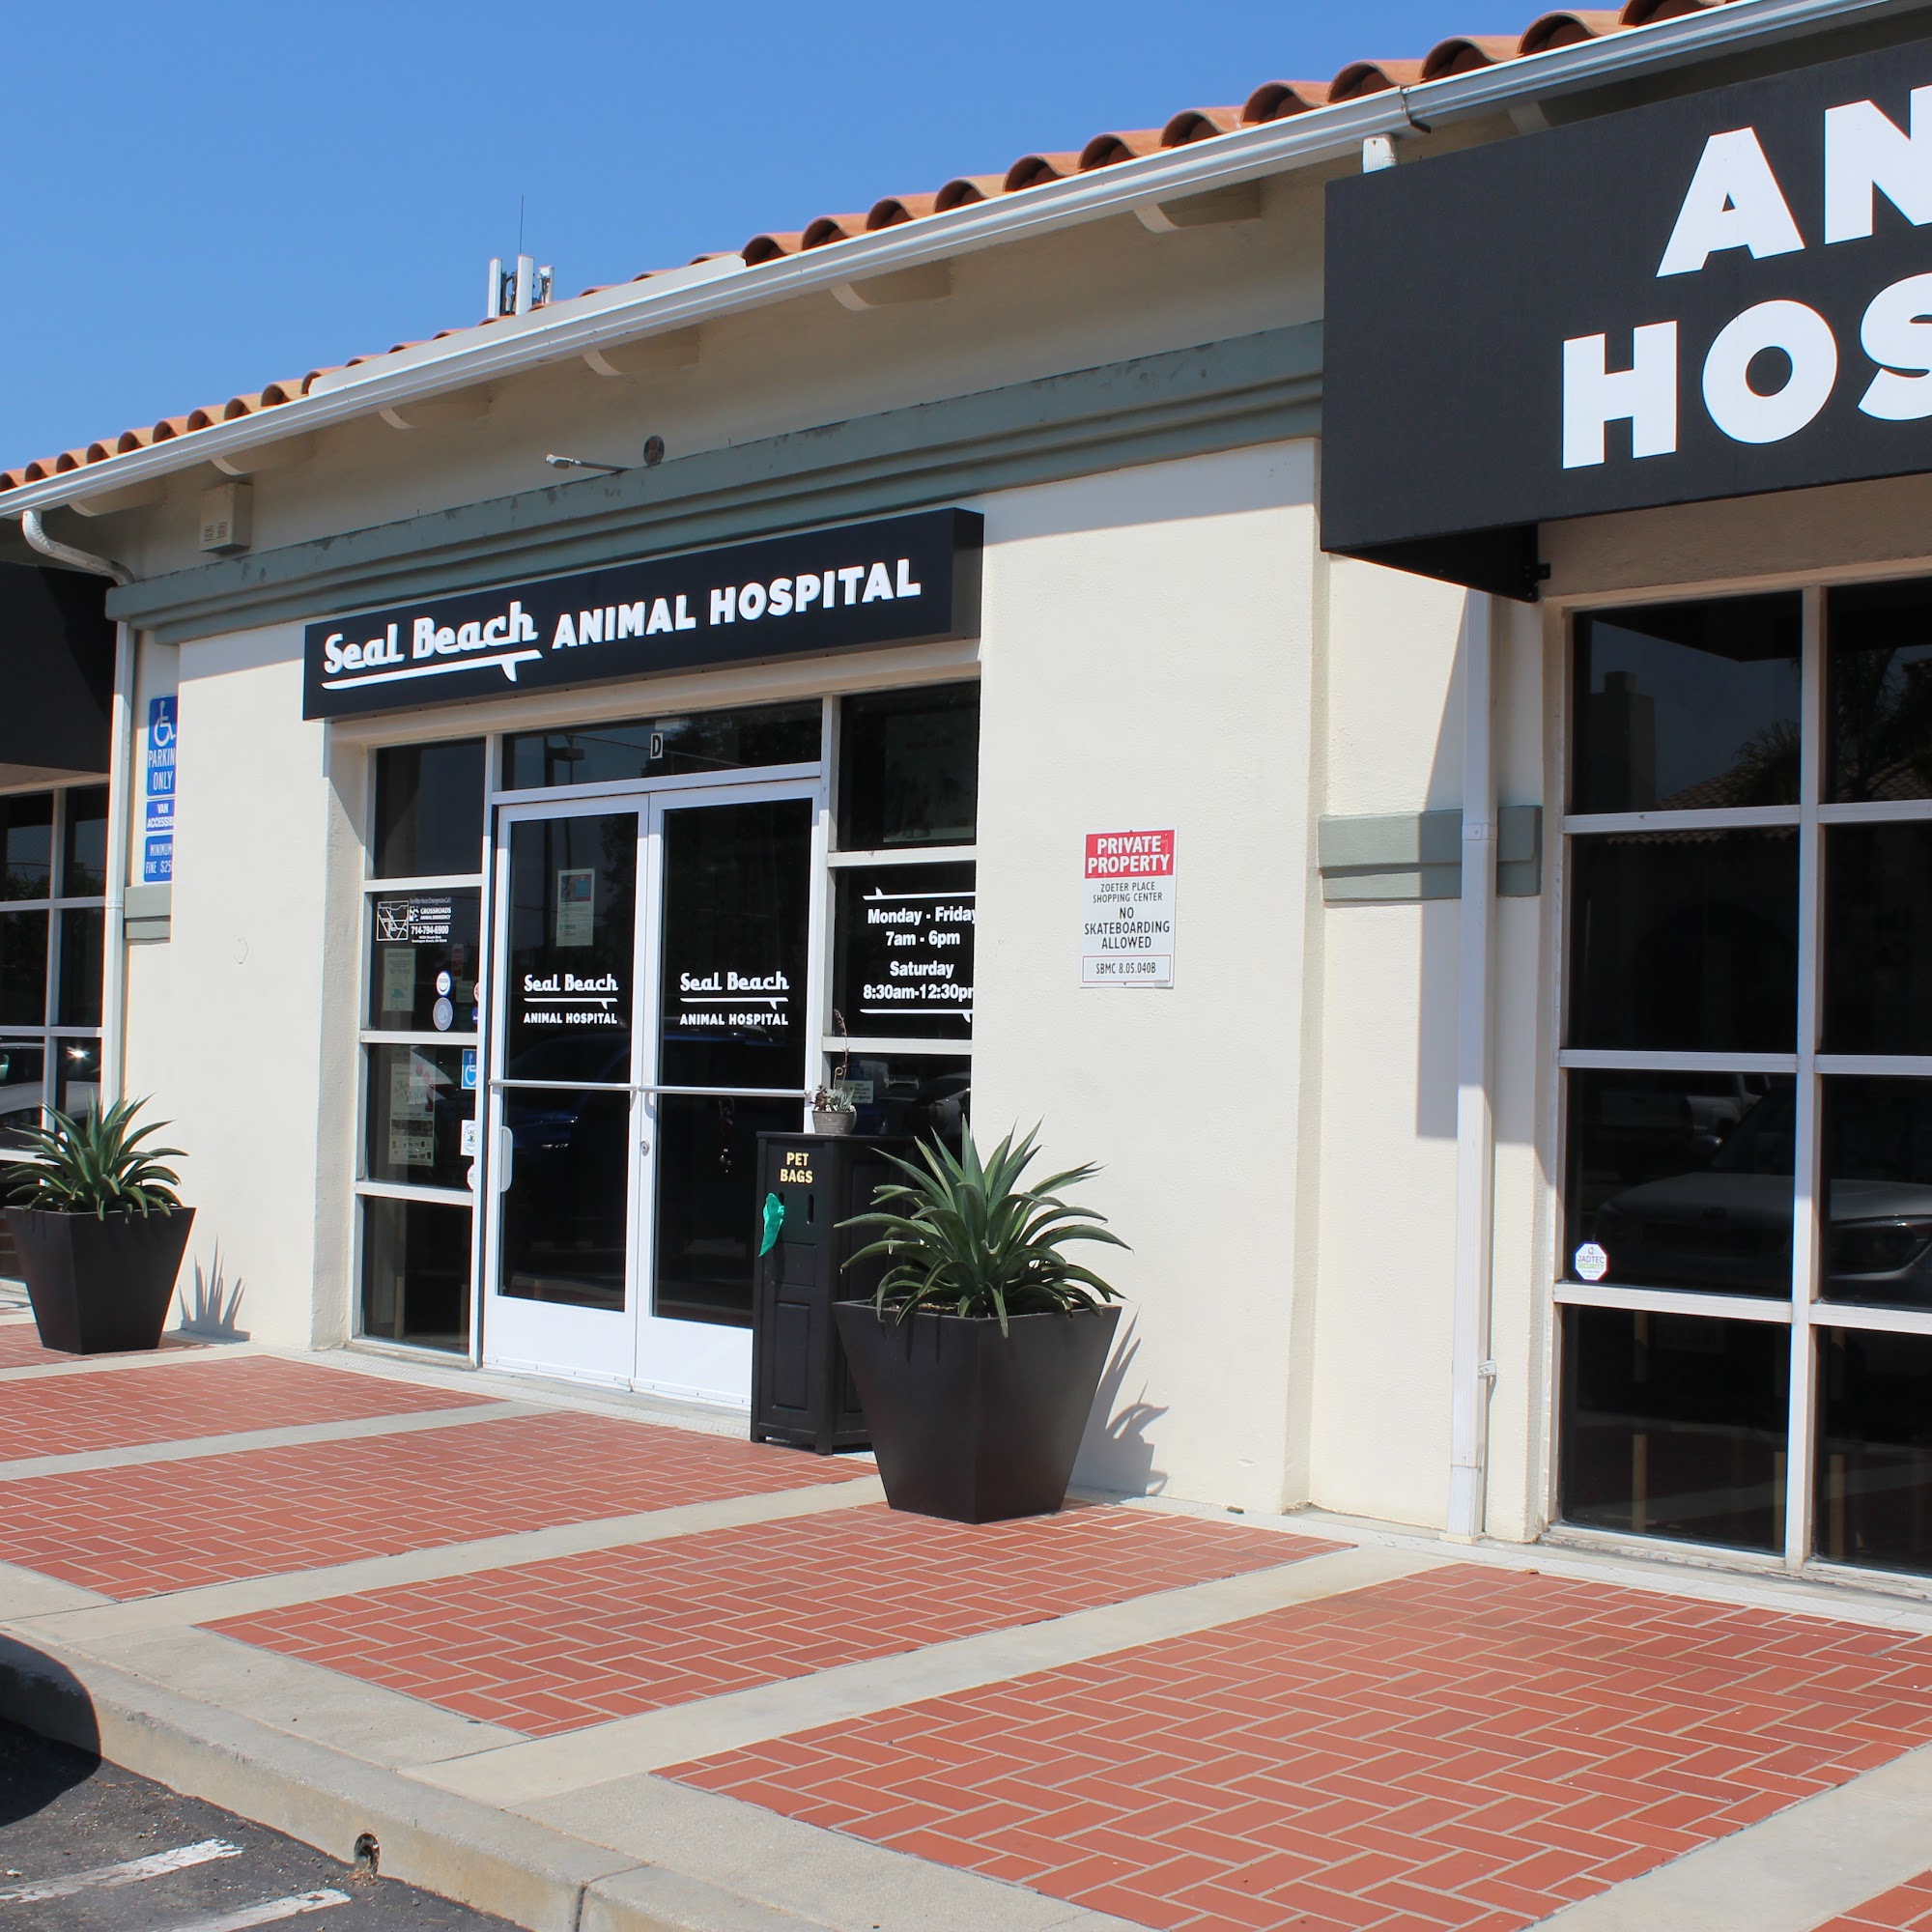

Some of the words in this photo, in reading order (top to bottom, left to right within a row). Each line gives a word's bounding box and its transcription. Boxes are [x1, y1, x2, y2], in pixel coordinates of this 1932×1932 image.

[1656, 84, 1932, 278] AN
[1563, 272, 1932, 469] HOS
[324, 623, 405, 674] Seal
[412, 601, 539, 661] Beach
[552, 594, 696, 650] ANIMAL
[709, 558, 921, 626] HOSPITAL
[652, 734, 662, 757] D
[148, 747, 176, 768] PARKIN
[153, 771, 174, 791] ONLY
[157, 803, 169, 814] VAN
[147, 816, 174, 829] ACCESSIB
[1096, 835, 1162, 855] PRIVATE
[146, 862, 157, 874] FINE
[1088, 854, 1171, 874] PROPERTY
[1100, 883, 1129, 893] ZOETER
[1131, 881, 1155, 891] PLACE
[1093, 894, 1131, 903] SHOPPING
[1133, 892, 1163, 901] CENTER
[867, 907, 923, 925] Monday
[1119, 907, 1134, 919] NO
[1084, 921, 1170, 935] SKATEBOARDING
[886, 931, 916, 946] 7am
[928, 930, 961, 949] 6pm
[1101, 936, 1151, 950] ALLOWED
[890, 960, 954, 979] Saturday
[1095, 962, 1116, 975] SBMC
[1119, 961, 1156, 974] 8.05.040B
[524, 974, 560, 992] Seal
[564, 973, 618, 992] Beach
[680, 972, 723, 992] Seal
[726, 971, 789, 991] Beach
[524, 1012, 562, 1024] ANIMAL
[565, 1012, 618, 1025] HOSPITAL
[679, 1013, 724, 1026] ANIMAL
[728, 1013, 789, 1026] HOSPITAL
[786, 1151, 810, 1166] PET
[780, 1168, 813, 1183] BAGS
